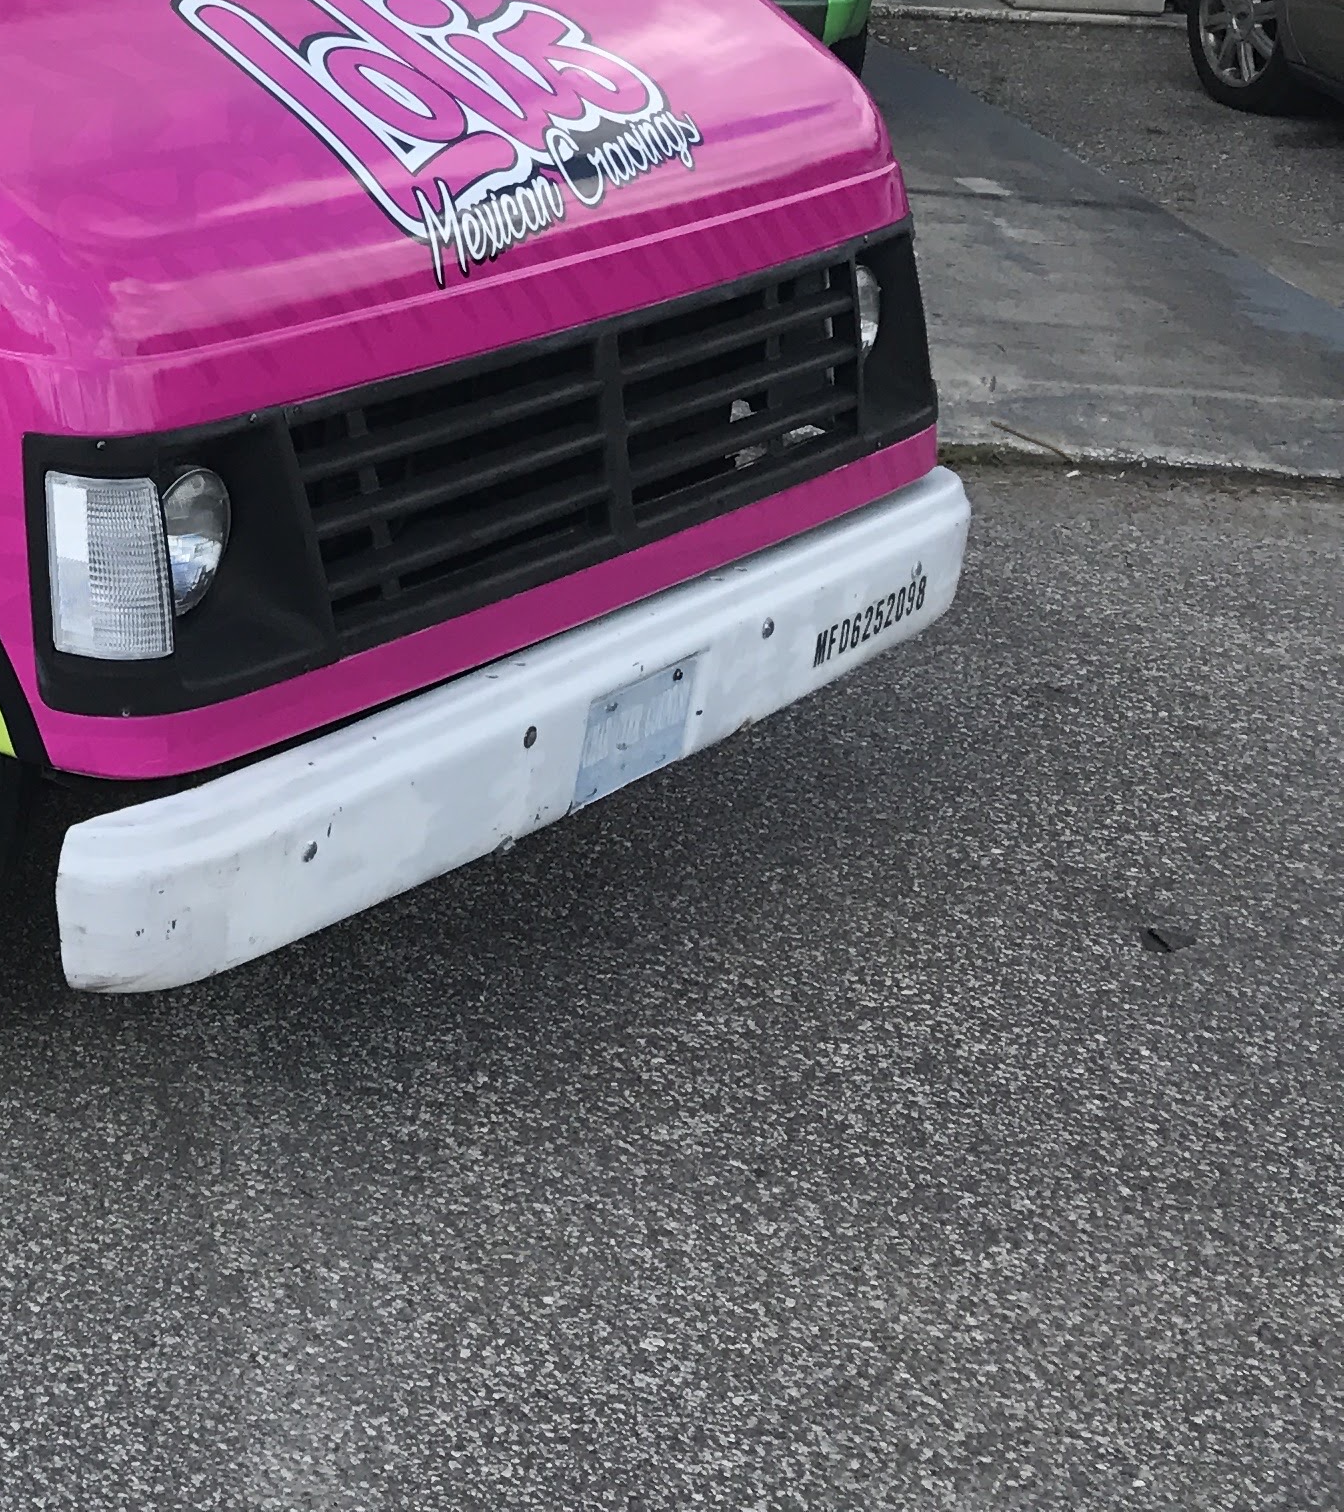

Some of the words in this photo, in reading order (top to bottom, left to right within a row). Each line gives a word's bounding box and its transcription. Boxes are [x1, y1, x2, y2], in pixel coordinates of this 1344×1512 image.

[414, 176, 564, 288] Mexican
[547, 111, 702, 207] Cravings
[812, 575, 928, 668] MFD6252098
